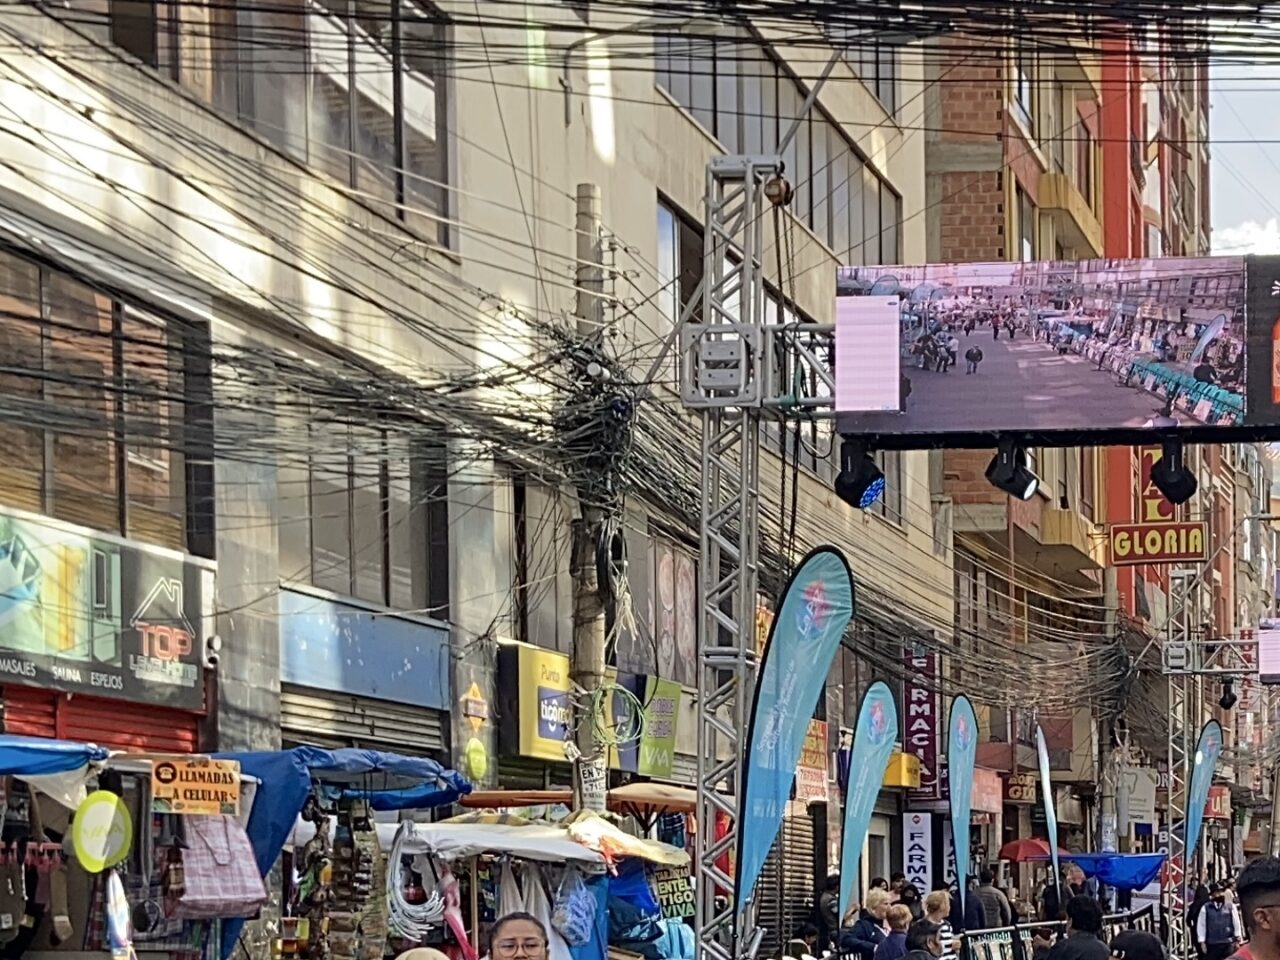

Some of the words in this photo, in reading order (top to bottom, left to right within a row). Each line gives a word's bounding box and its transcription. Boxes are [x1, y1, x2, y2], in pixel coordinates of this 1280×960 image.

[1114, 528, 1202, 556] GLORIA
[137, 624, 192, 660] TOP
[0, 658, 36, 677] MASAJES
[52, 666, 81, 683] SAUNA
[91, 672, 123, 690] ESPEJOS
[180, 770, 234, 785] LLAMADAS
[173, 788, 179, 800] A
[183, 788, 228, 802] CELULAR
[658, 879, 690, 894] ENTEL
[660, 891, 693, 906] TIGO
[663, 903, 695, 918] VIVA
